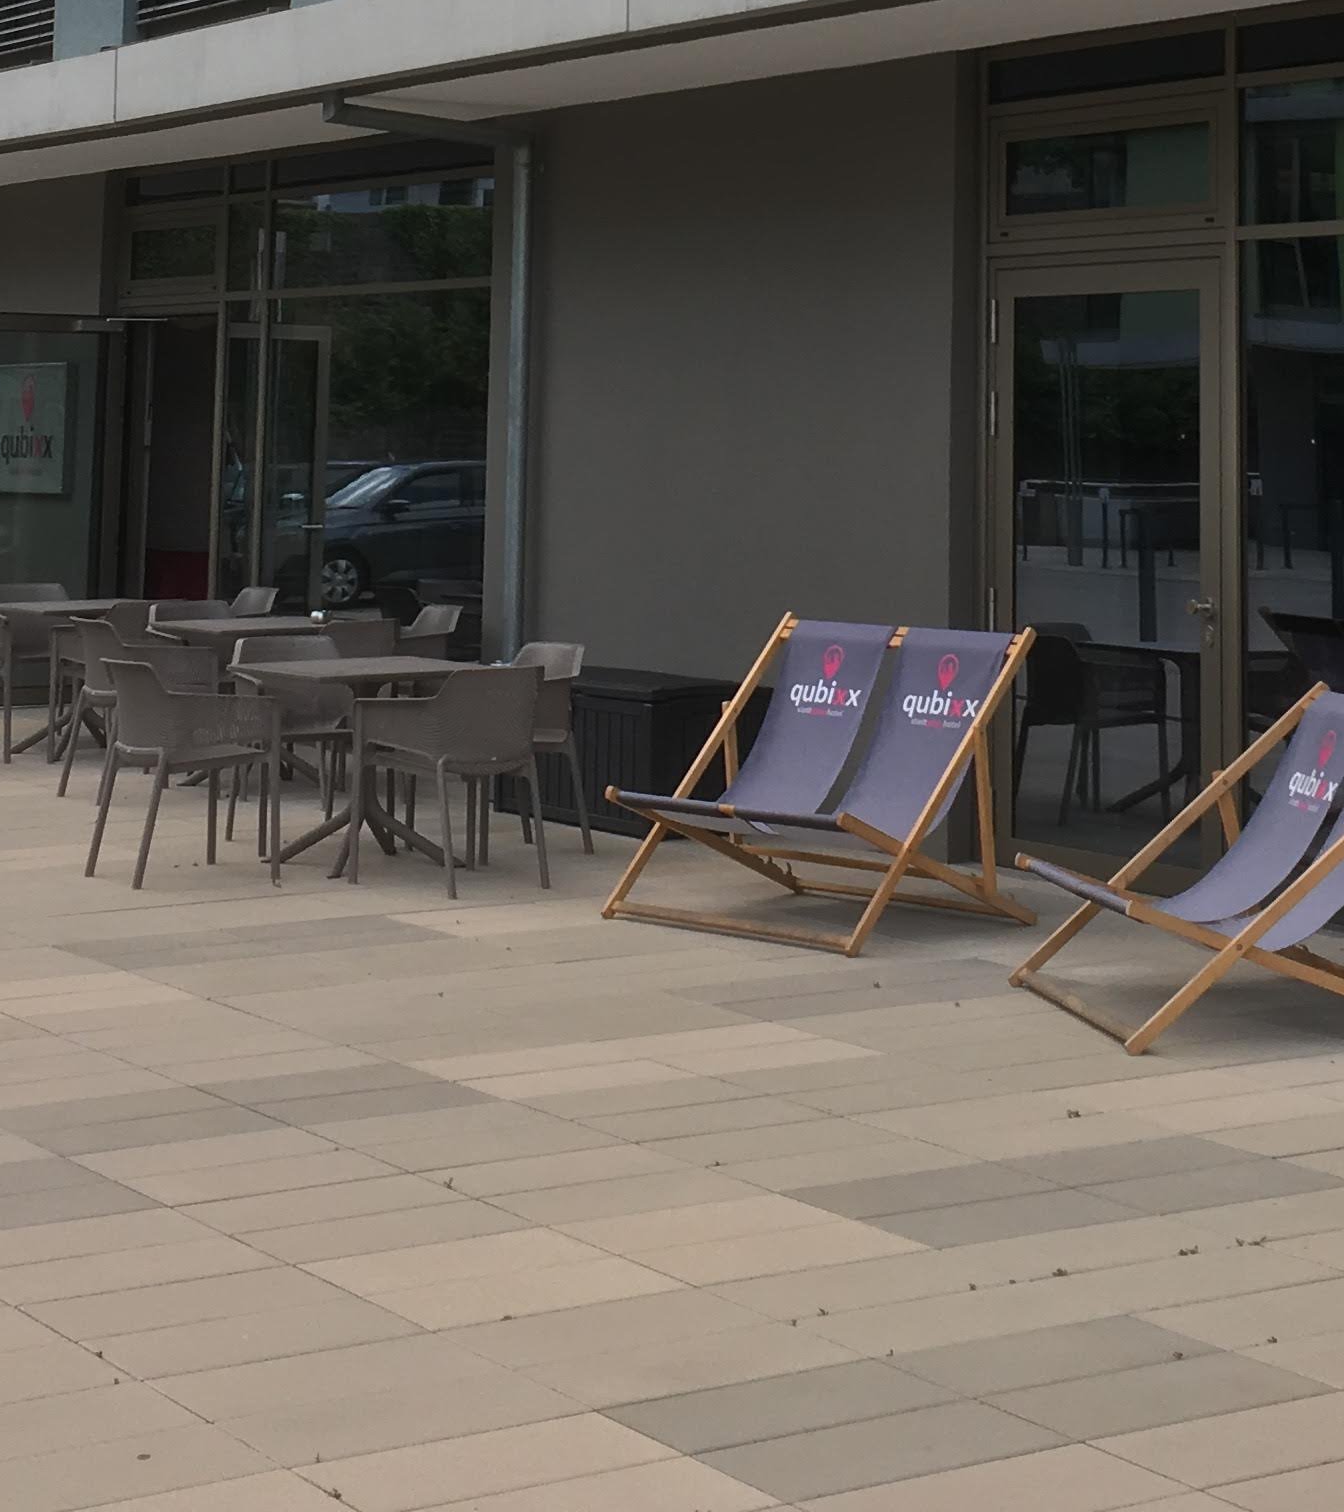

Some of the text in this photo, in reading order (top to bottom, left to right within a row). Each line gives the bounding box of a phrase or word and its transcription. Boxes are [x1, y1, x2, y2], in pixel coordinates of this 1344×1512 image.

[0, 425, 54, 465] qubixx
[790, 679, 862, 707] qubixx
[902, 690, 979, 718] qubixx
[1288, 769, 1339, 802] qubixx
